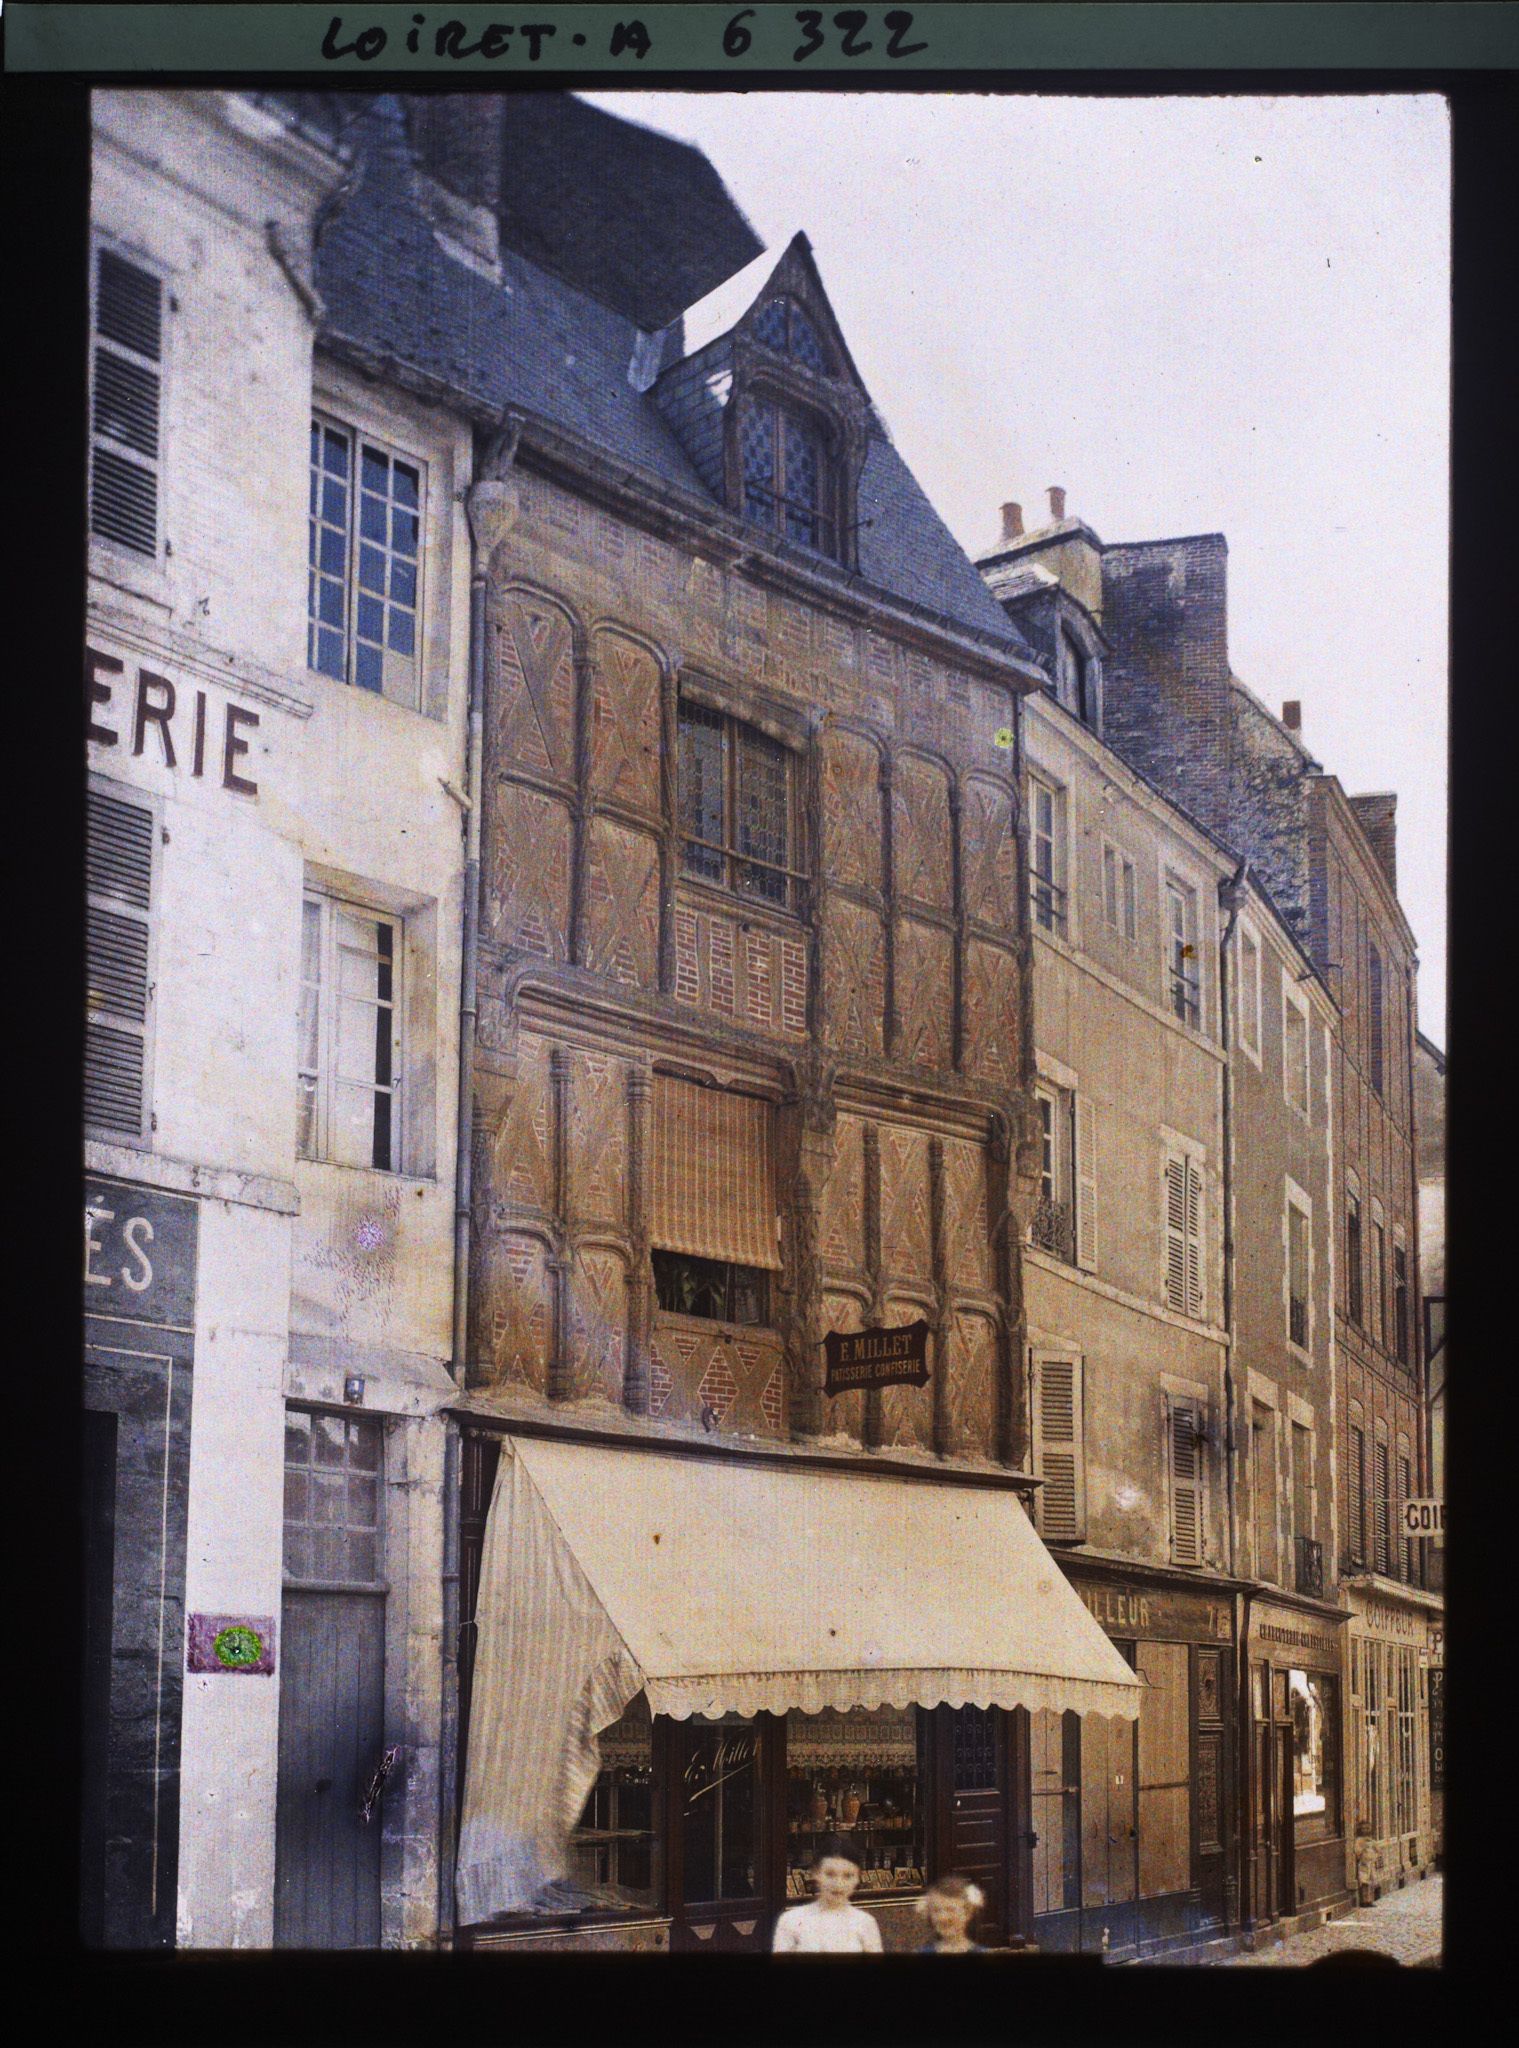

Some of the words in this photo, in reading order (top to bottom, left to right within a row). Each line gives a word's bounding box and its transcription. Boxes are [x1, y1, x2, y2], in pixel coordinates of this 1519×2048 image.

[84, 645, 260, 796] ERIE
[854, 1333, 913, 1361] MILLET
[874, 1358, 921, 1378] CONFISERIE
[1078, 1589, 1150, 1628] ILLEUR
[1365, 1600, 1414, 1637] COIFFEUR
